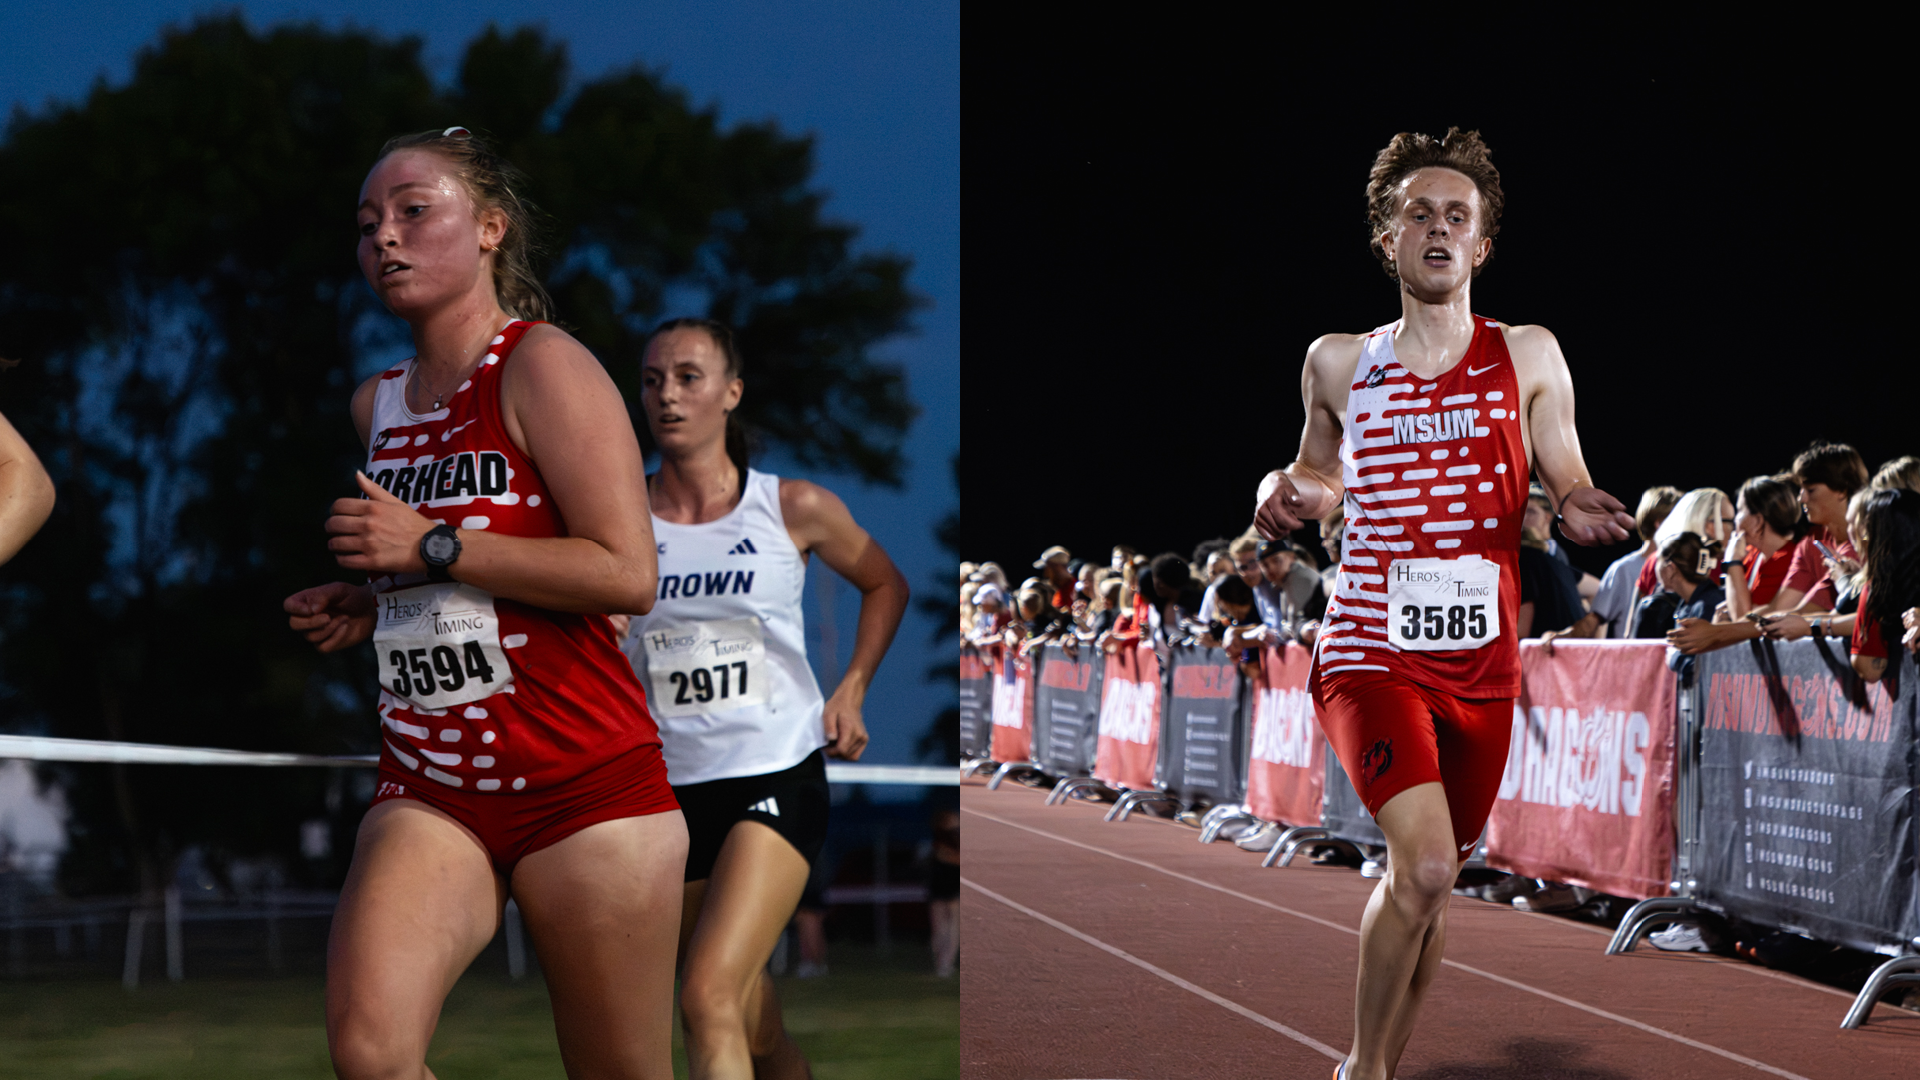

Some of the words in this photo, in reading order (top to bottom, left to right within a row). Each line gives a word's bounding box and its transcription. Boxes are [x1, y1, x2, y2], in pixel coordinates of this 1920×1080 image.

[1392, 408, 1476, 445] MSUM
[361, 452, 507, 503] ORHEAD
[657, 570, 755, 600] ROWN
[1453, 580, 1489, 597] TIMING
[432, 612, 483, 635] TIMING
[1401, 604, 1487, 641] 3585
[389, 640, 494, 698] 3594
[669, 660, 748, 705] 2977
